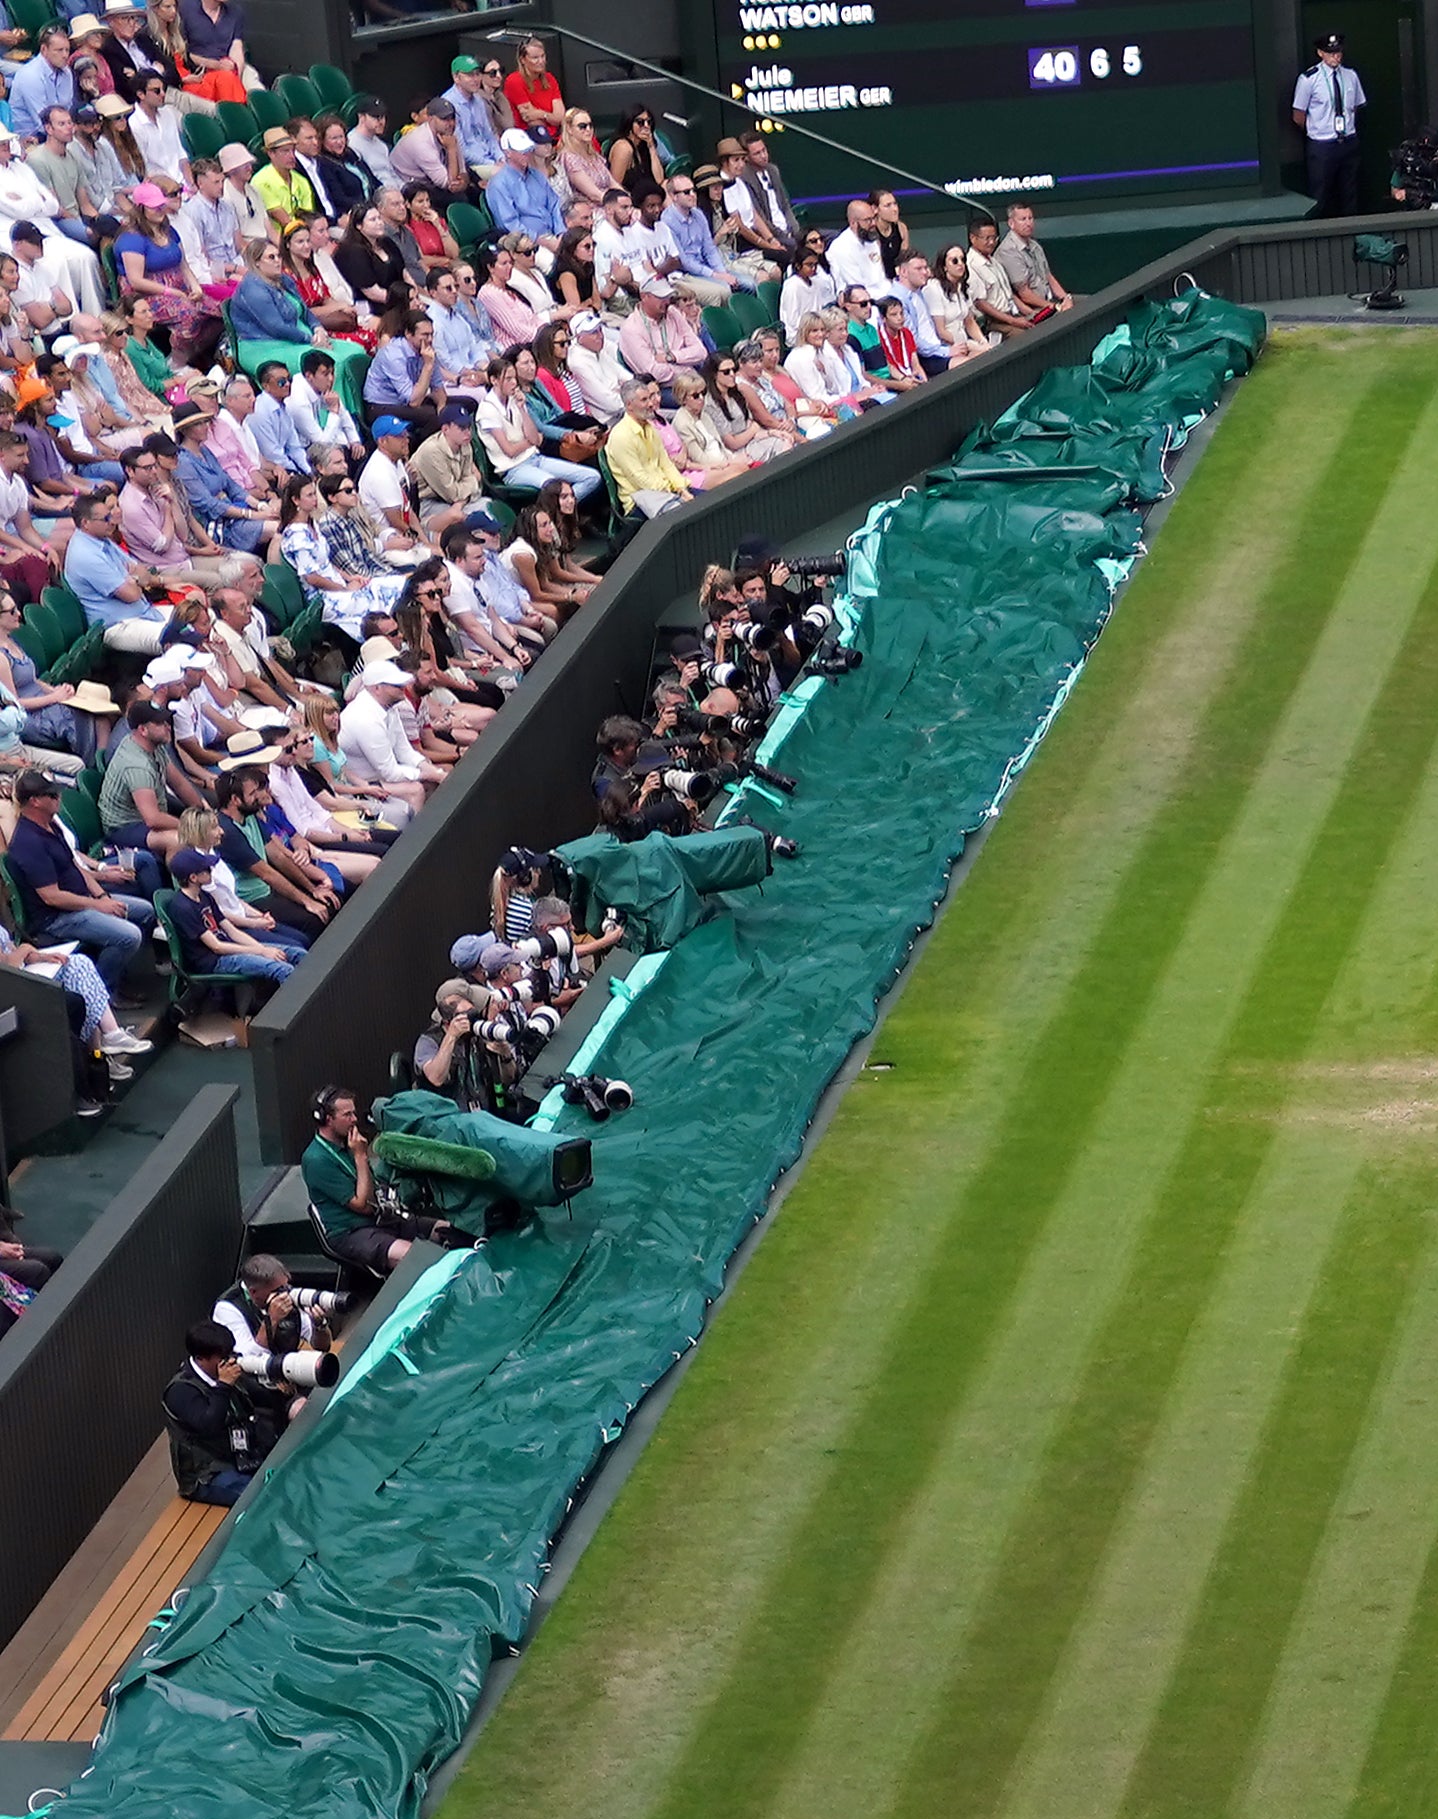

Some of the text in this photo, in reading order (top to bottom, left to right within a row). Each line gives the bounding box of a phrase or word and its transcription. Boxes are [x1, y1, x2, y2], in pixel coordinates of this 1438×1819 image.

[740, 3, 875, 30] WATSON GBR
[745, 64, 793, 89] Jule
[747, 45, 1142, 114] NIEMEIER GER 40 6 5
[944, 175, 1053, 196] wimbledon.com
